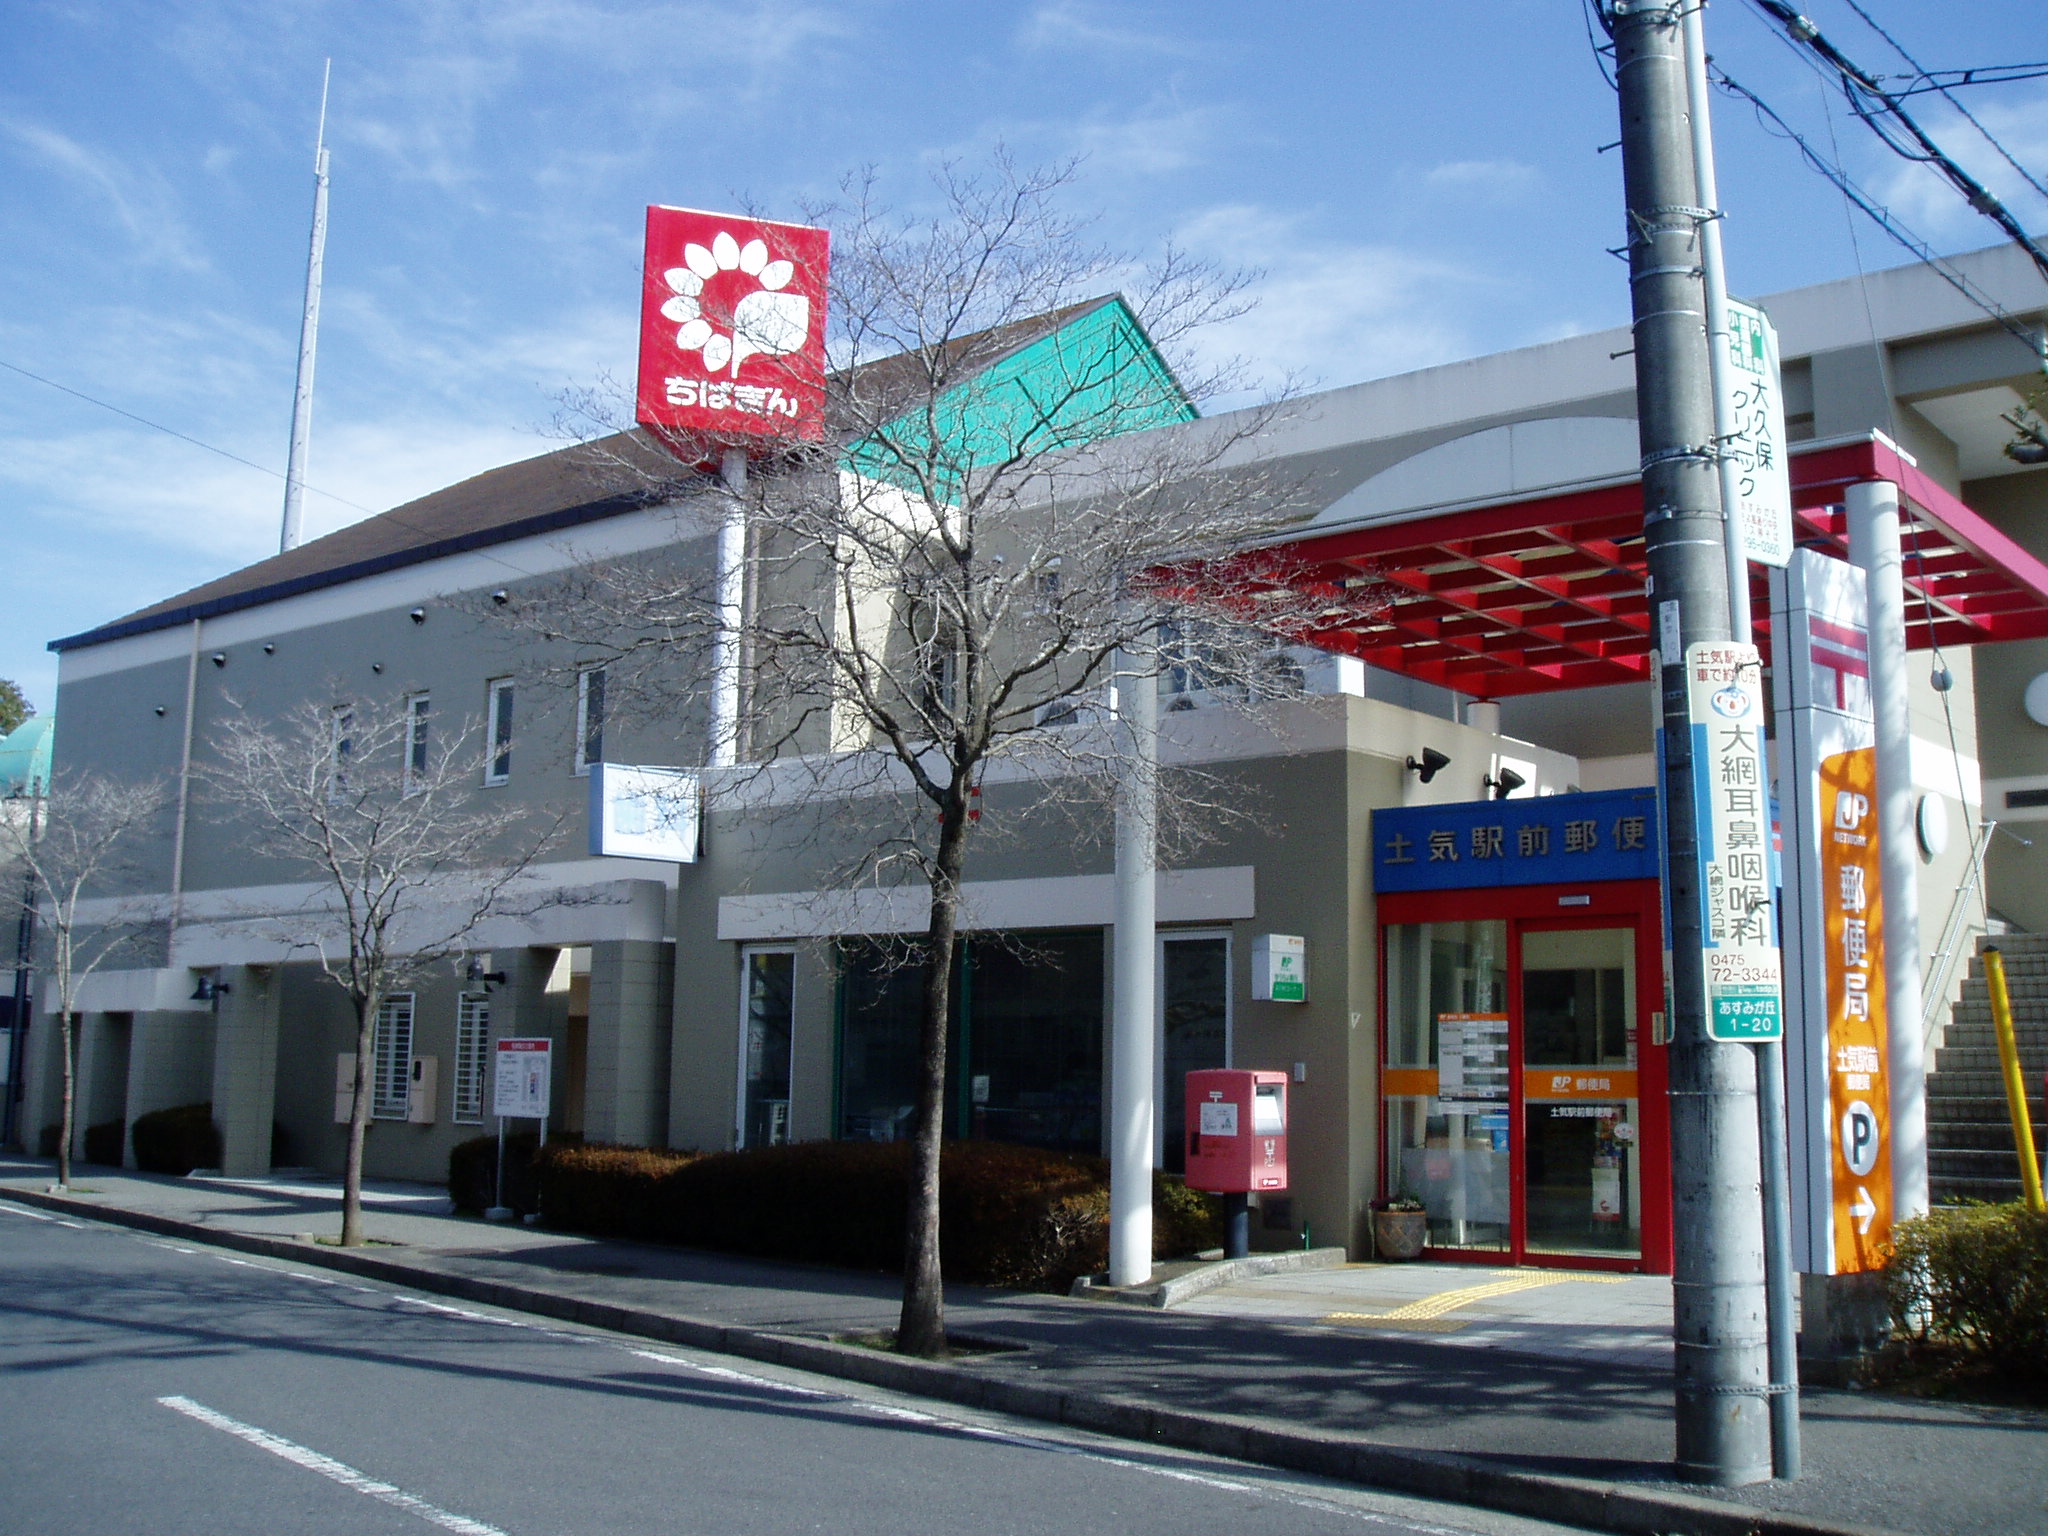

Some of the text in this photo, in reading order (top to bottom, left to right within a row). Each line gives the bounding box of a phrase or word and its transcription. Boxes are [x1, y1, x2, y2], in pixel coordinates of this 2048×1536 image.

[664, 375, 799, 418] ちばぎん
[1732, 390, 1755, 497] クリニック
[1751, 378, 1773, 471] 大久保
[1697, 669, 1756, 684] 車で約0分
[1383, 816, 1647, 864] 土気駅前郵便
[1720, 724, 1767, 946] 大網耳鼻咽喉科
[1711, 955, 1745, 966] 0475
[1840, 865, 1868, 1022] 郵便局
[1711, 968, 1777, 982] 72-3344
[1720, 1001, 1776, 1015] あすみが丘
[1730, 1018, 1772, 1032] 1-20
[1837, 1045, 1879, 1073] 土気駅前
[1852, 1114, 1870, 1164] P
